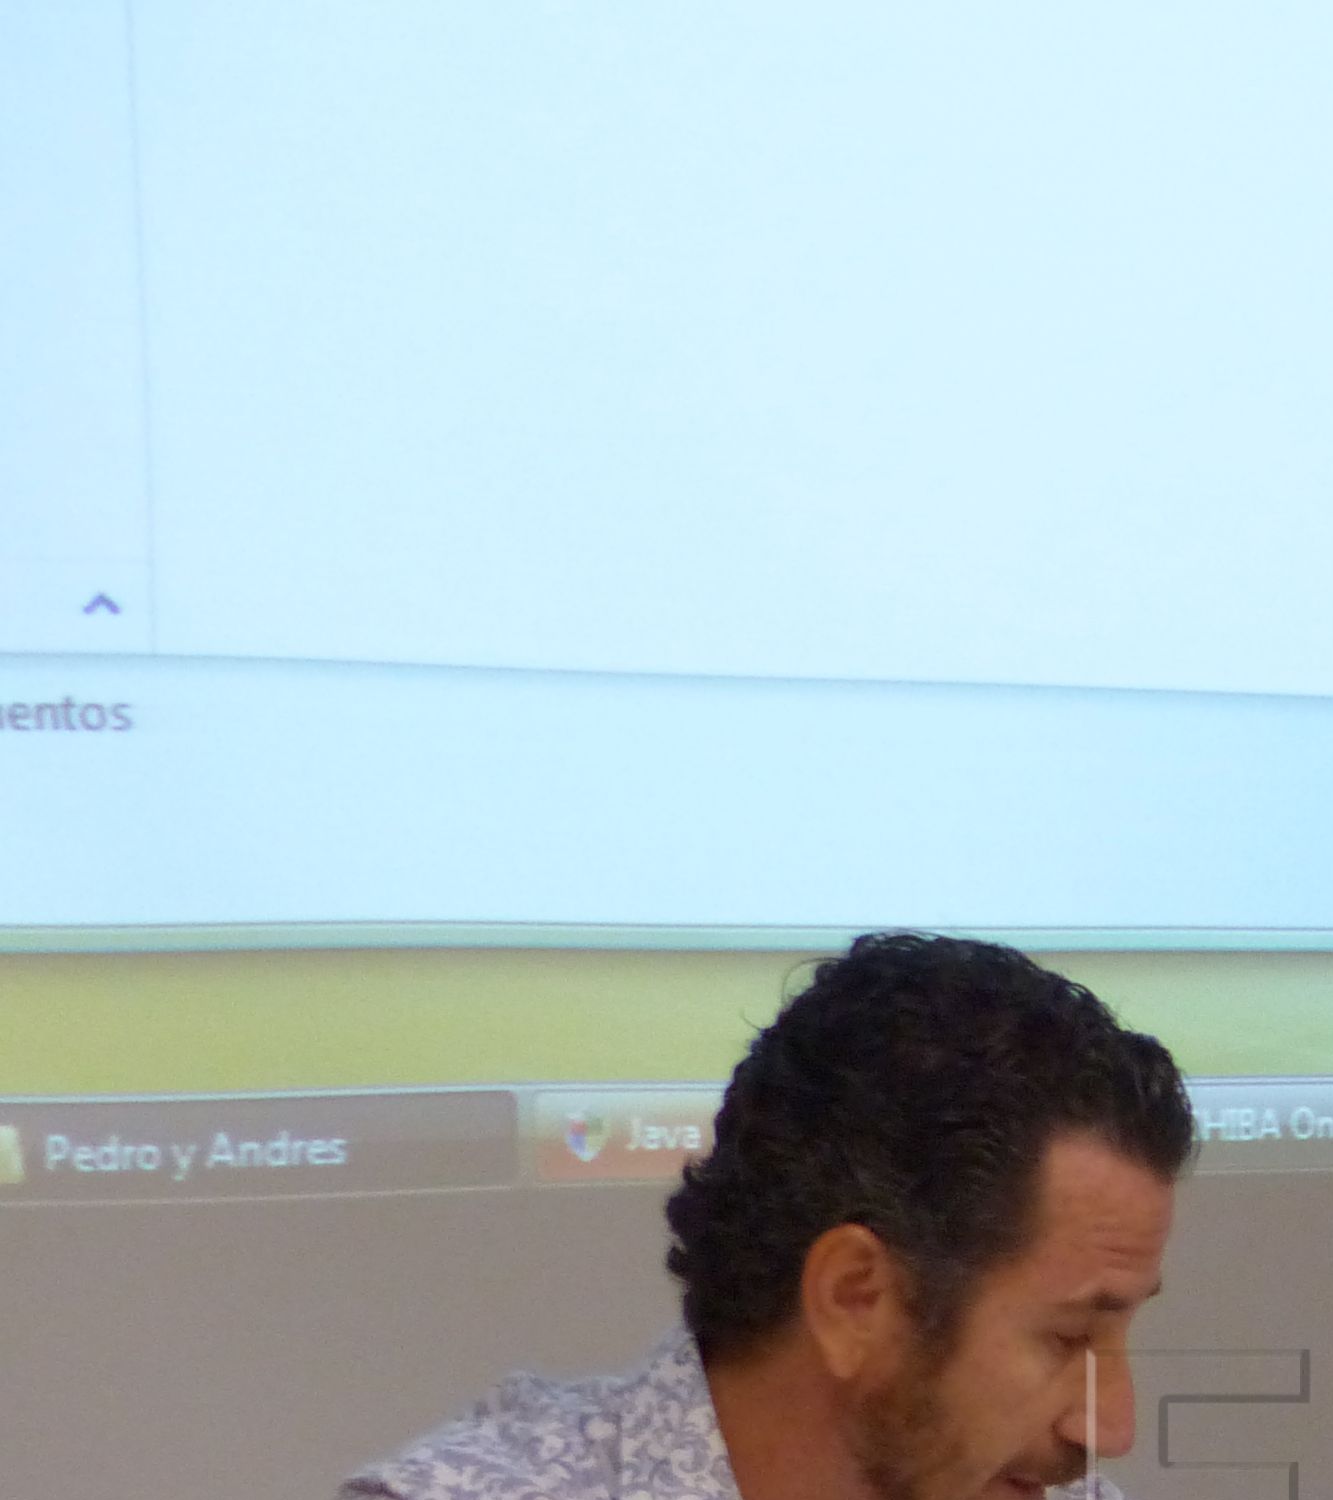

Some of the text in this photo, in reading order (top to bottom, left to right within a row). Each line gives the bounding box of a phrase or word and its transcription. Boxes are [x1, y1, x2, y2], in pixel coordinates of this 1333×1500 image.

[0, 697, 134, 731] entos
[625, 1115, 701, 1150] Java
[1194, 1107, 1282, 1142] HIBA
[46, 1133, 161, 1172] Pedro
[171, 1143, 197, 1181] y
